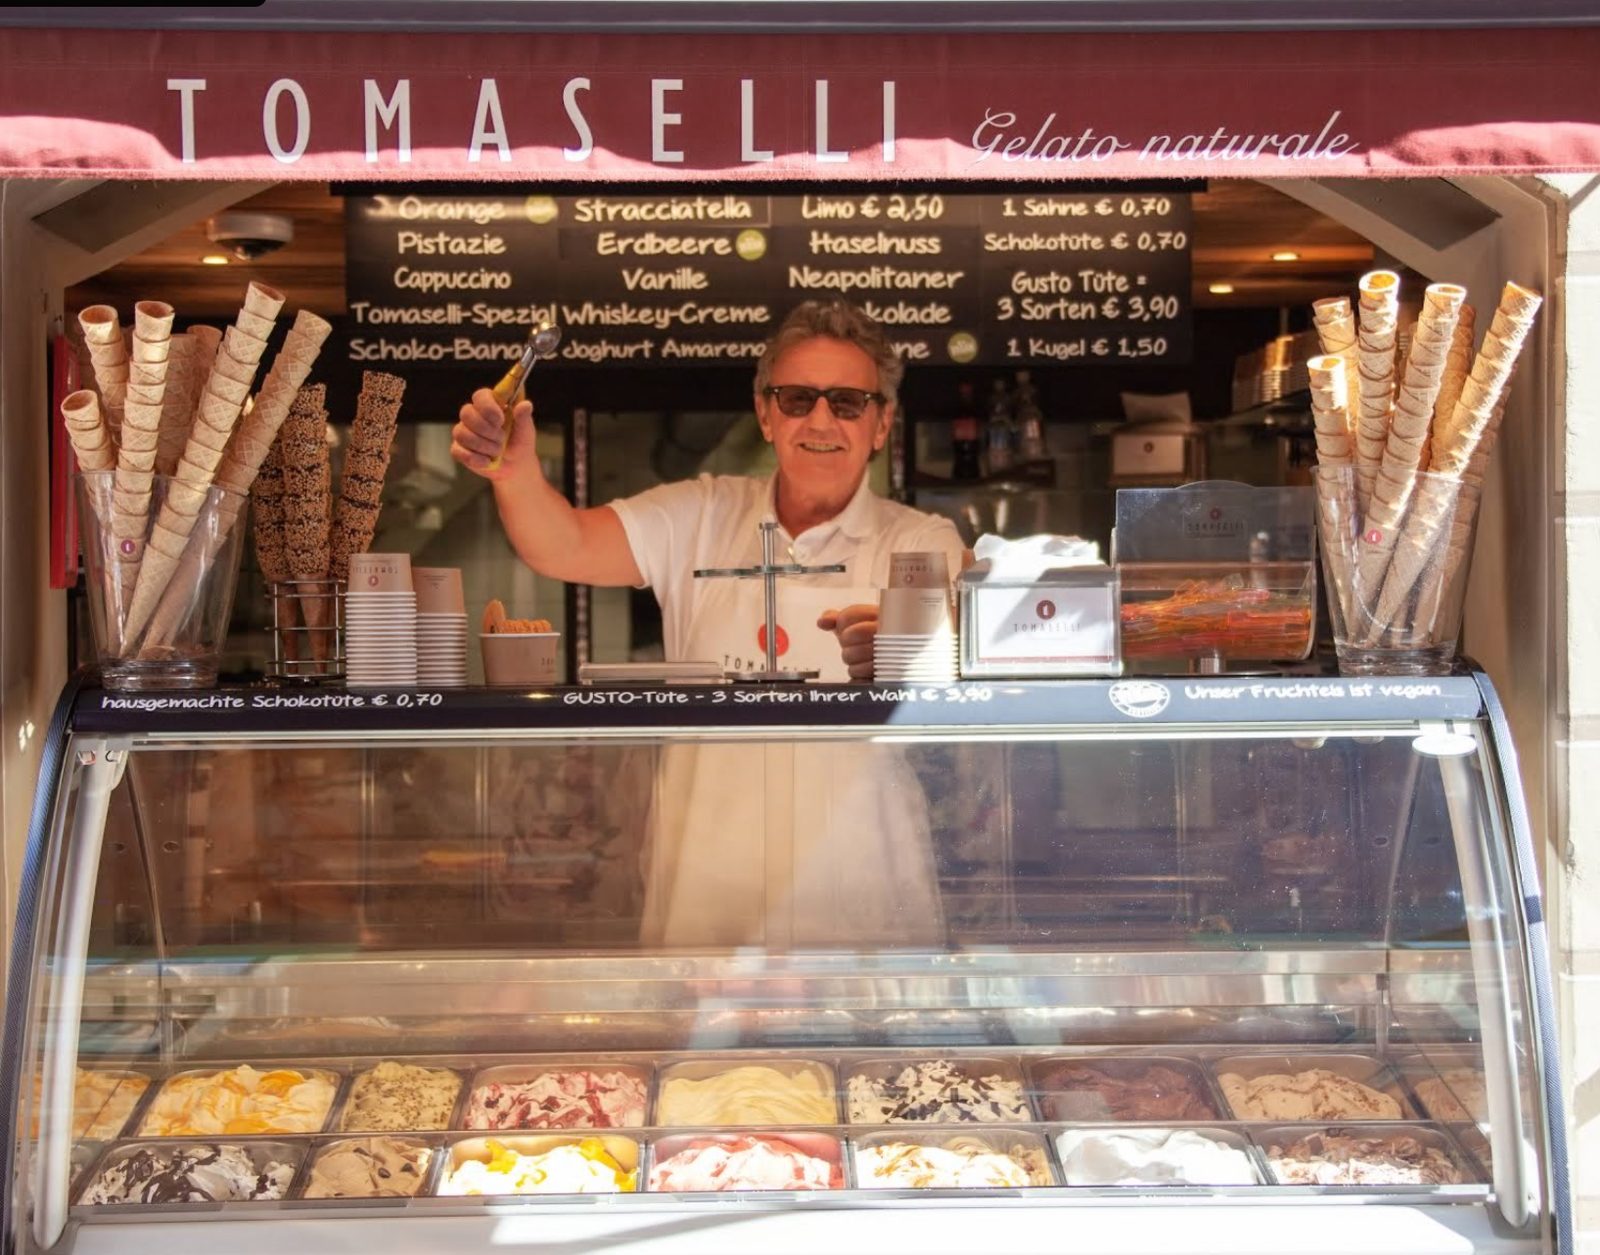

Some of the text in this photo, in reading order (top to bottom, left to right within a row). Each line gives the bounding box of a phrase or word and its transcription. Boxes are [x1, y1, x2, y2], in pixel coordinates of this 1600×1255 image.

[167, 78, 896, 164] TOMASELLI
[971, 107, 1360, 165] Gelato naturale
[399, 196, 505, 224] Orange
[574, 196, 752, 222] Stracciatella
[801, 195, 944, 221] Limo € 2,50
[1003, 198, 1171, 218] 1 Sahne € 0,70
[398, 231, 506, 255] Pistazie
[597, 232, 732, 255] Erdbeere
[809, 230, 941, 254] Haselnuss
[1110, 233, 1129, 250] €
[1137, 232, 1187, 252] 0,70
[394, 266, 512, 293] Cappuccino
[622, 267, 709, 291] Vanille
[788, 265, 965, 293] Neapolitaner
[1011, 271, 1072, 294] Gusto
[1078, 270, 1129, 293] Tüte
[350, 302, 557, 328] Tomaselli-Spezial
[562, 302, 771, 329] Whiskey-Creme
[997, 296, 1179, 322] 3 Sorten € 3,90
[562, 339, 654, 362] Joghurt
[1007, 338, 1167, 360] 1 Kugel € 1,50
[101, 695, 245, 711] hausgemachte
[371, 695, 389, 707] €
[396, 693, 443, 708] 0,70
[712, 690, 727, 702] 3
[733, 689, 803, 703] Sorten
[809, 688, 861, 702] Ihrer
[1184, 685, 1246, 699] Unser
[1379, 685, 1442, 699] vegan
